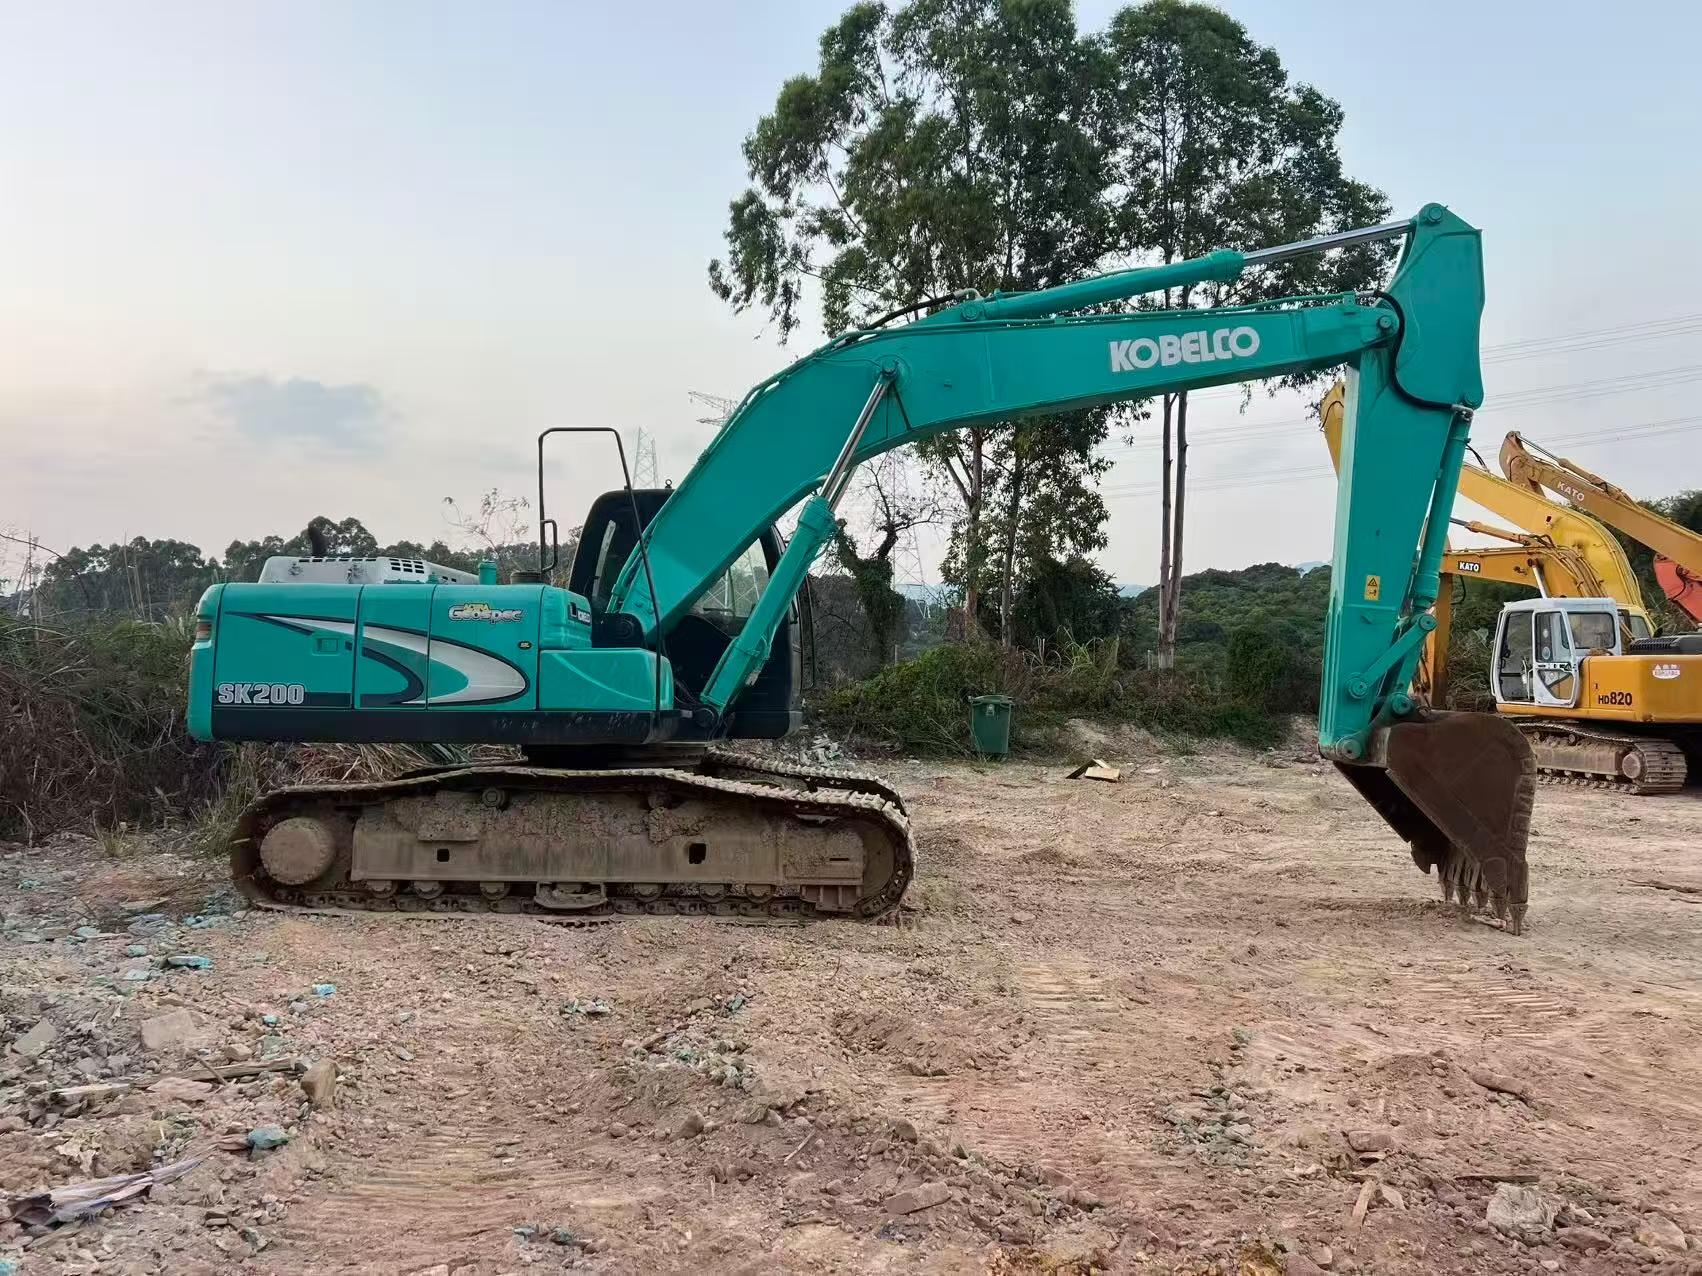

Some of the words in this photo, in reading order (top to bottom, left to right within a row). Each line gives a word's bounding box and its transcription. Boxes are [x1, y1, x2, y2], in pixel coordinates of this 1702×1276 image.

[1109, 326, 1260, 372] KOBELCO
[1557, 481, 1585, 502] KATO
[1460, 562, 1480, 572] KATO
[218, 683, 305, 704] SK200
[1598, 692, 1633, 706] HD820
